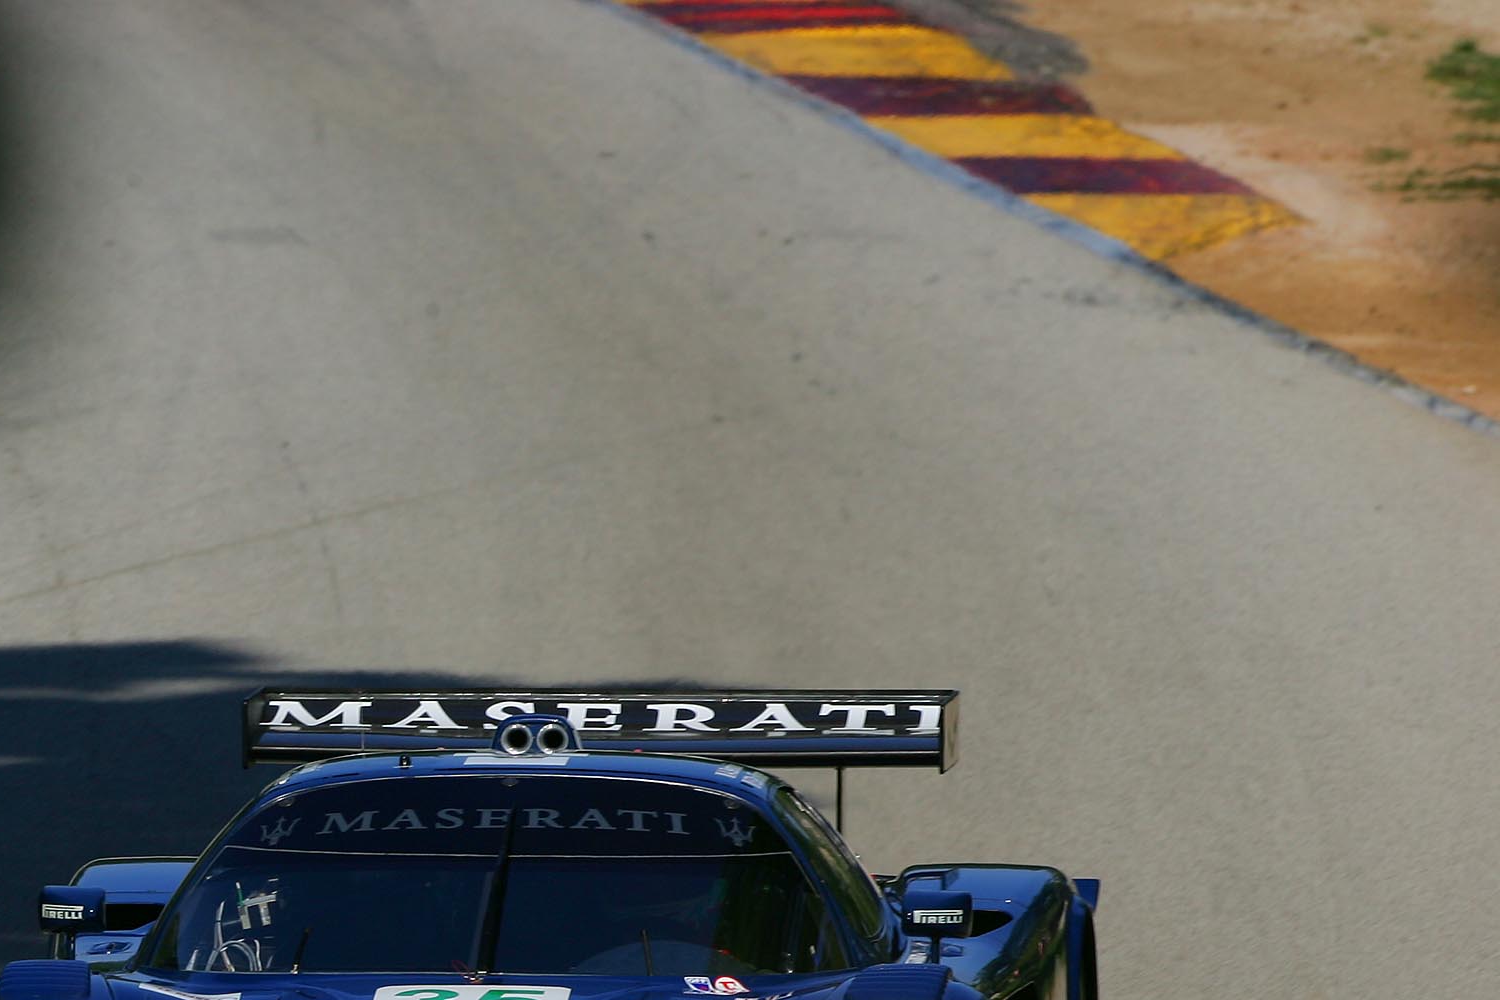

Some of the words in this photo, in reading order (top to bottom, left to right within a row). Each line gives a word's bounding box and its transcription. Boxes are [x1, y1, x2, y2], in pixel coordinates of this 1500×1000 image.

[316, 807, 691, 835] MASERATI
[41, 903, 84, 920] PIRELLI
[912, 909, 964, 924] PIRELLI
